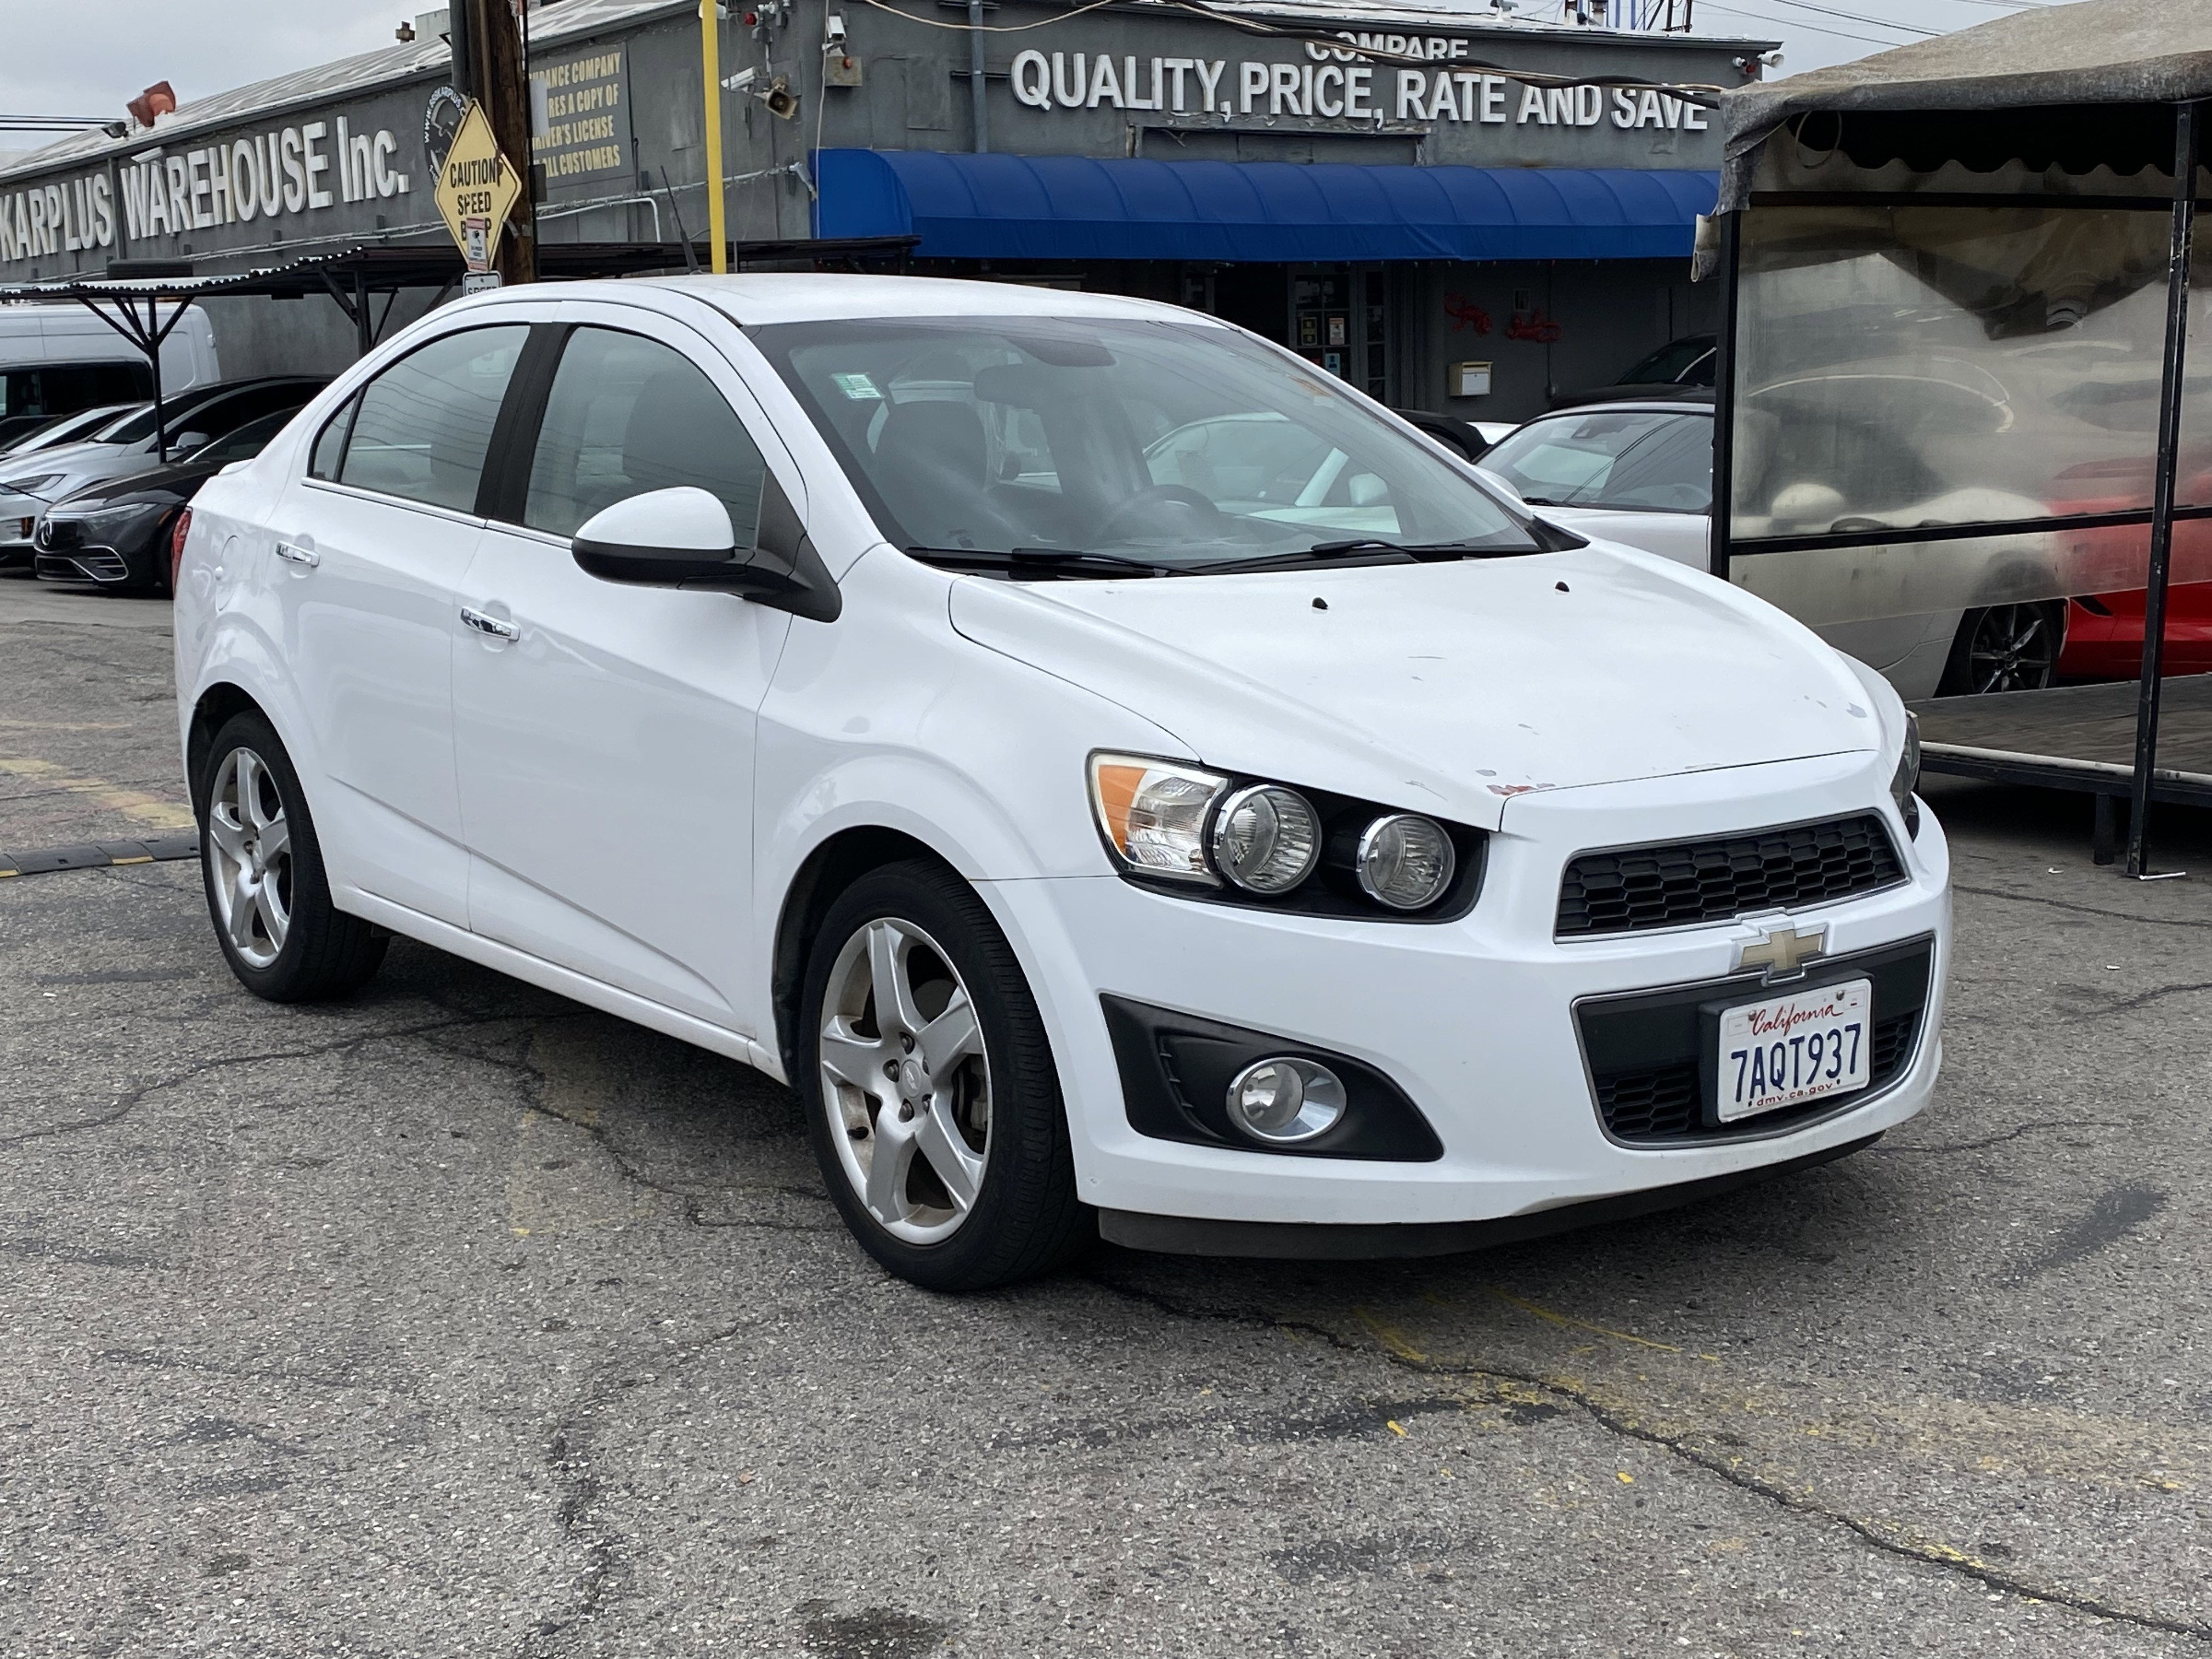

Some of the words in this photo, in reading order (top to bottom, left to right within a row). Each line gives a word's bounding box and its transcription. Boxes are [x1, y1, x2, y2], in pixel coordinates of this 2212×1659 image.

[1305, 31, 1469, 63] COMPARE
[572, 52, 620, 83] COMPANY
[568, 93, 575, 114] A
[577, 86, 603, 112] COPY
[606, 83, 618, 106] OF
[1011, 49, 1230, 122] QUALITY,
[1240, 61, 1383, 129] PRICE,
[1396, 70, 1506, 122] RATE
[1516, 84, 1602, 126] AND
[1611, 88, 1707, 129] SAVE
[573, 115, 614, 143] LICENSE
[450, 158, 496, 188] CAUTION
[560, 144, 620, 175] CUSTOMERS
[0, 173, 115, 262] KARPLUS
[120, 122, 333, 240] WAREHOUSE
[337, 116, 409, 202] Inc.
[458, 191, 491, 216] SPEED
[461, 217, 492, 241] BP
[1752, 1003, 1844, 1036] California
[1731, 1023, 1861, 1103] 7AQT937
[1757, 1082, 1833, 1106] dmv.ca.gov
